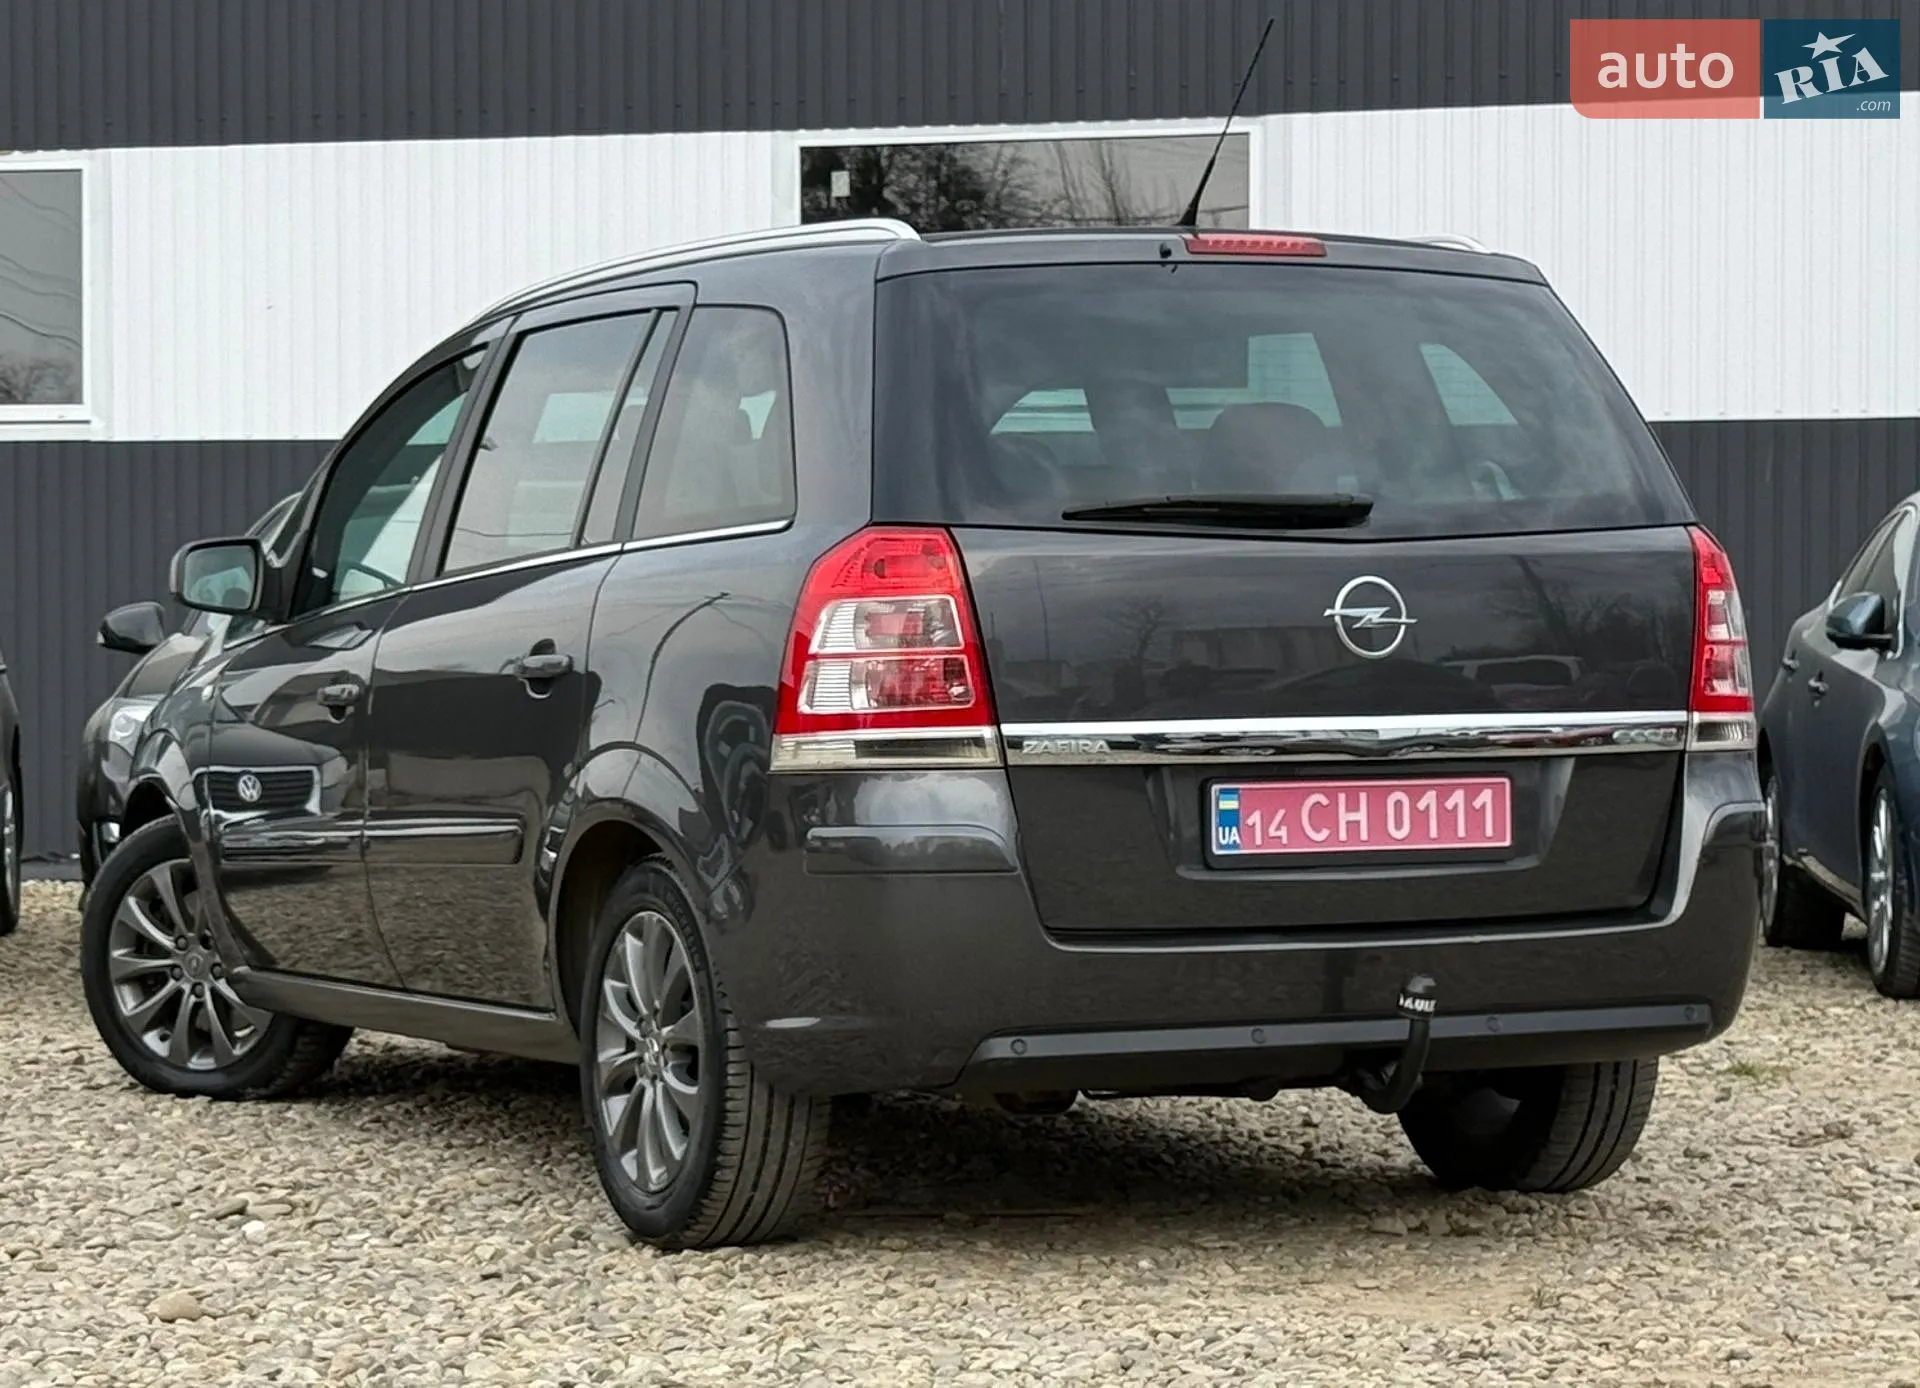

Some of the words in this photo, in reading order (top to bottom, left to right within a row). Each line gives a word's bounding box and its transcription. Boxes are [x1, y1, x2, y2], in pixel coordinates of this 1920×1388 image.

[1022, 739, 1112, 754] ZAFIRA
[1245, 809, 1288, 845] 14
[1300, 792, 1368, 842] CH
[1386, 789, 1493, 839] 0111
[1218, 826, 1241, 845] UA
